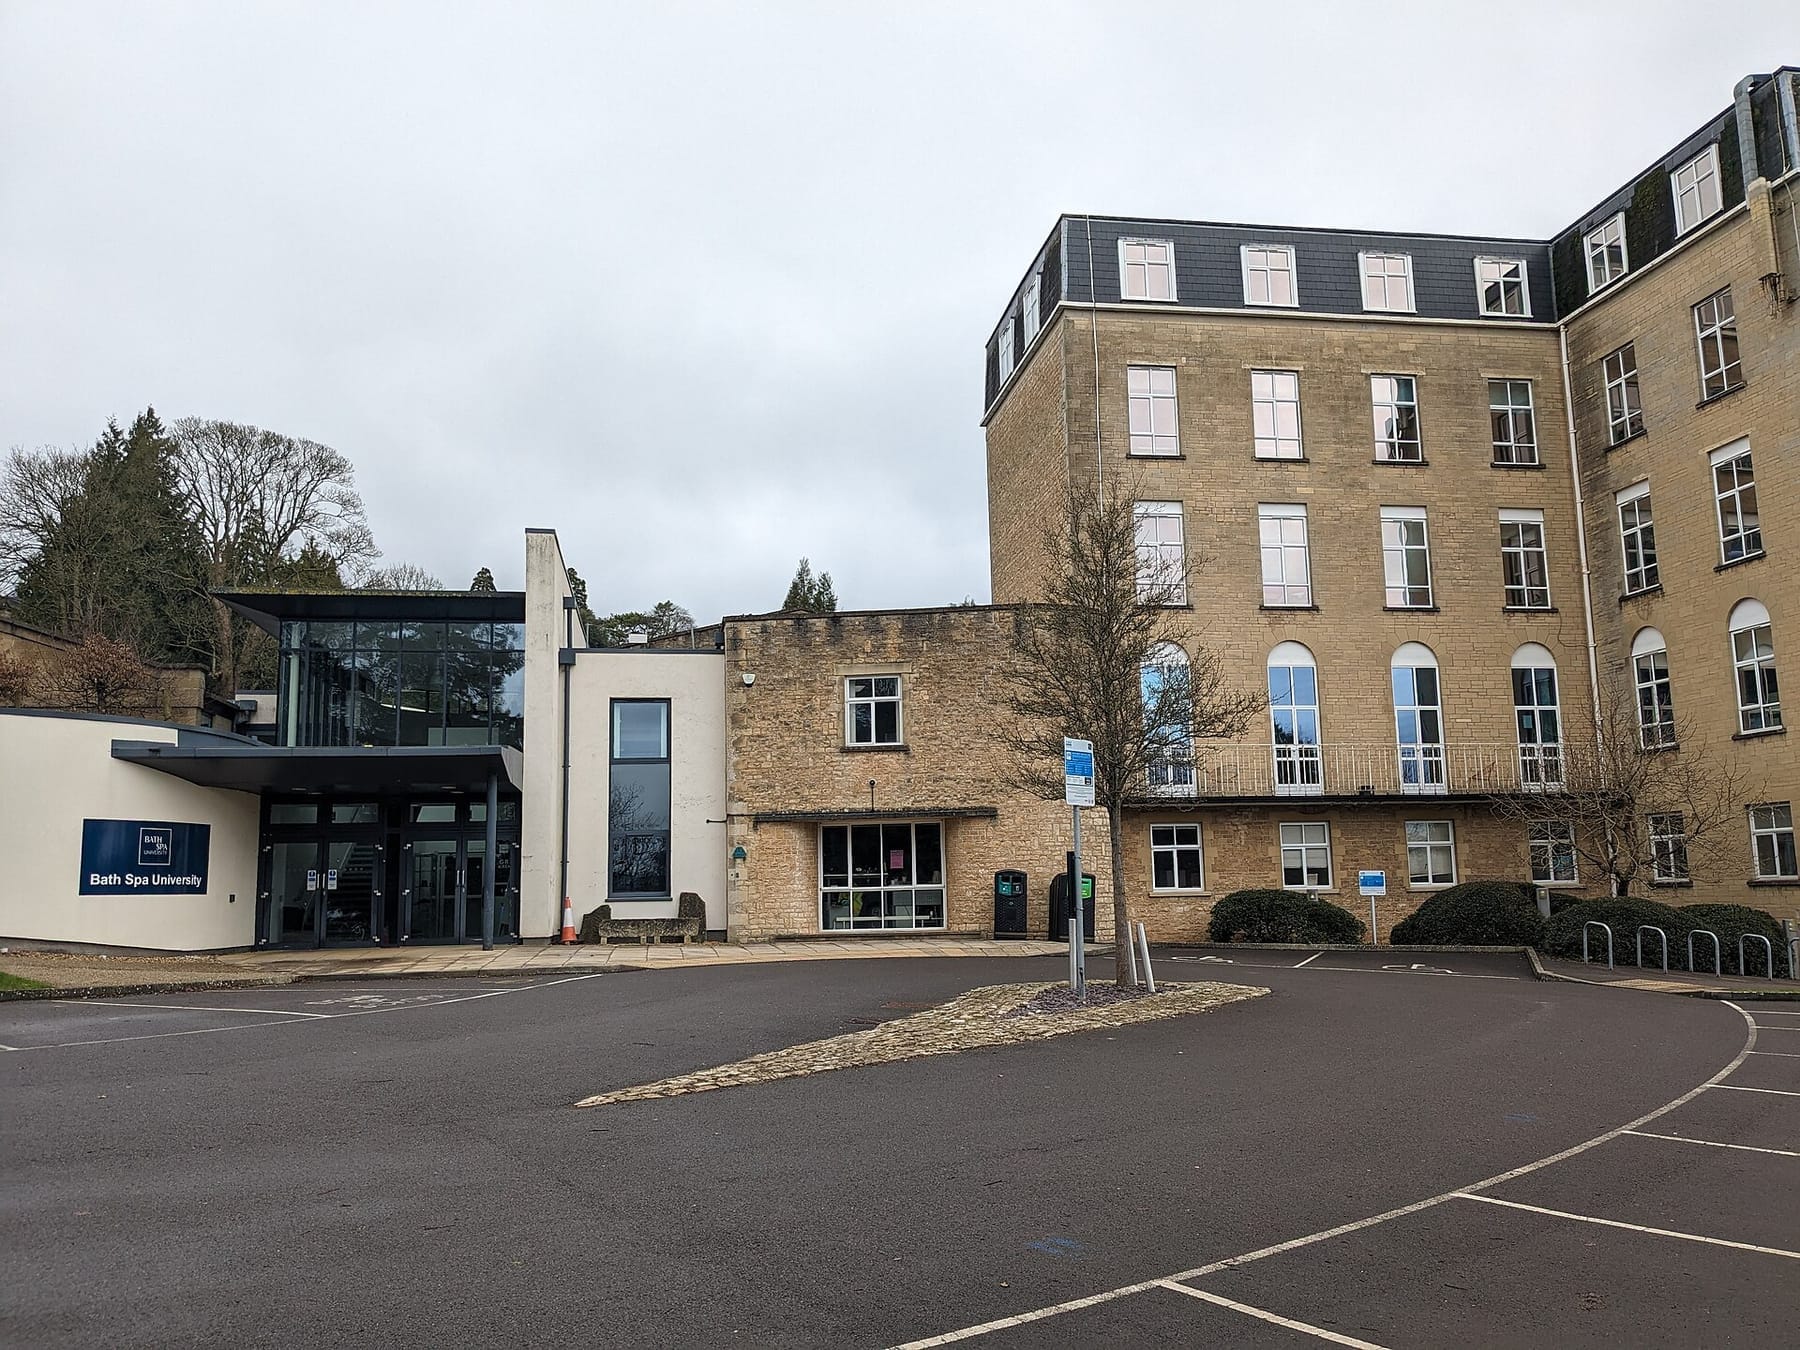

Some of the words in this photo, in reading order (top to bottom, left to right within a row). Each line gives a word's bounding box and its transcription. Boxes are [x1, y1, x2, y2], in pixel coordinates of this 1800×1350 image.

[144, 835, 163, 843] BATH
[155, 843, 168, 851] SPA
[90, 873, 121, 885] Bath
[125, 874, 149, 887] Spa
[152, 874, 202, 887] University
